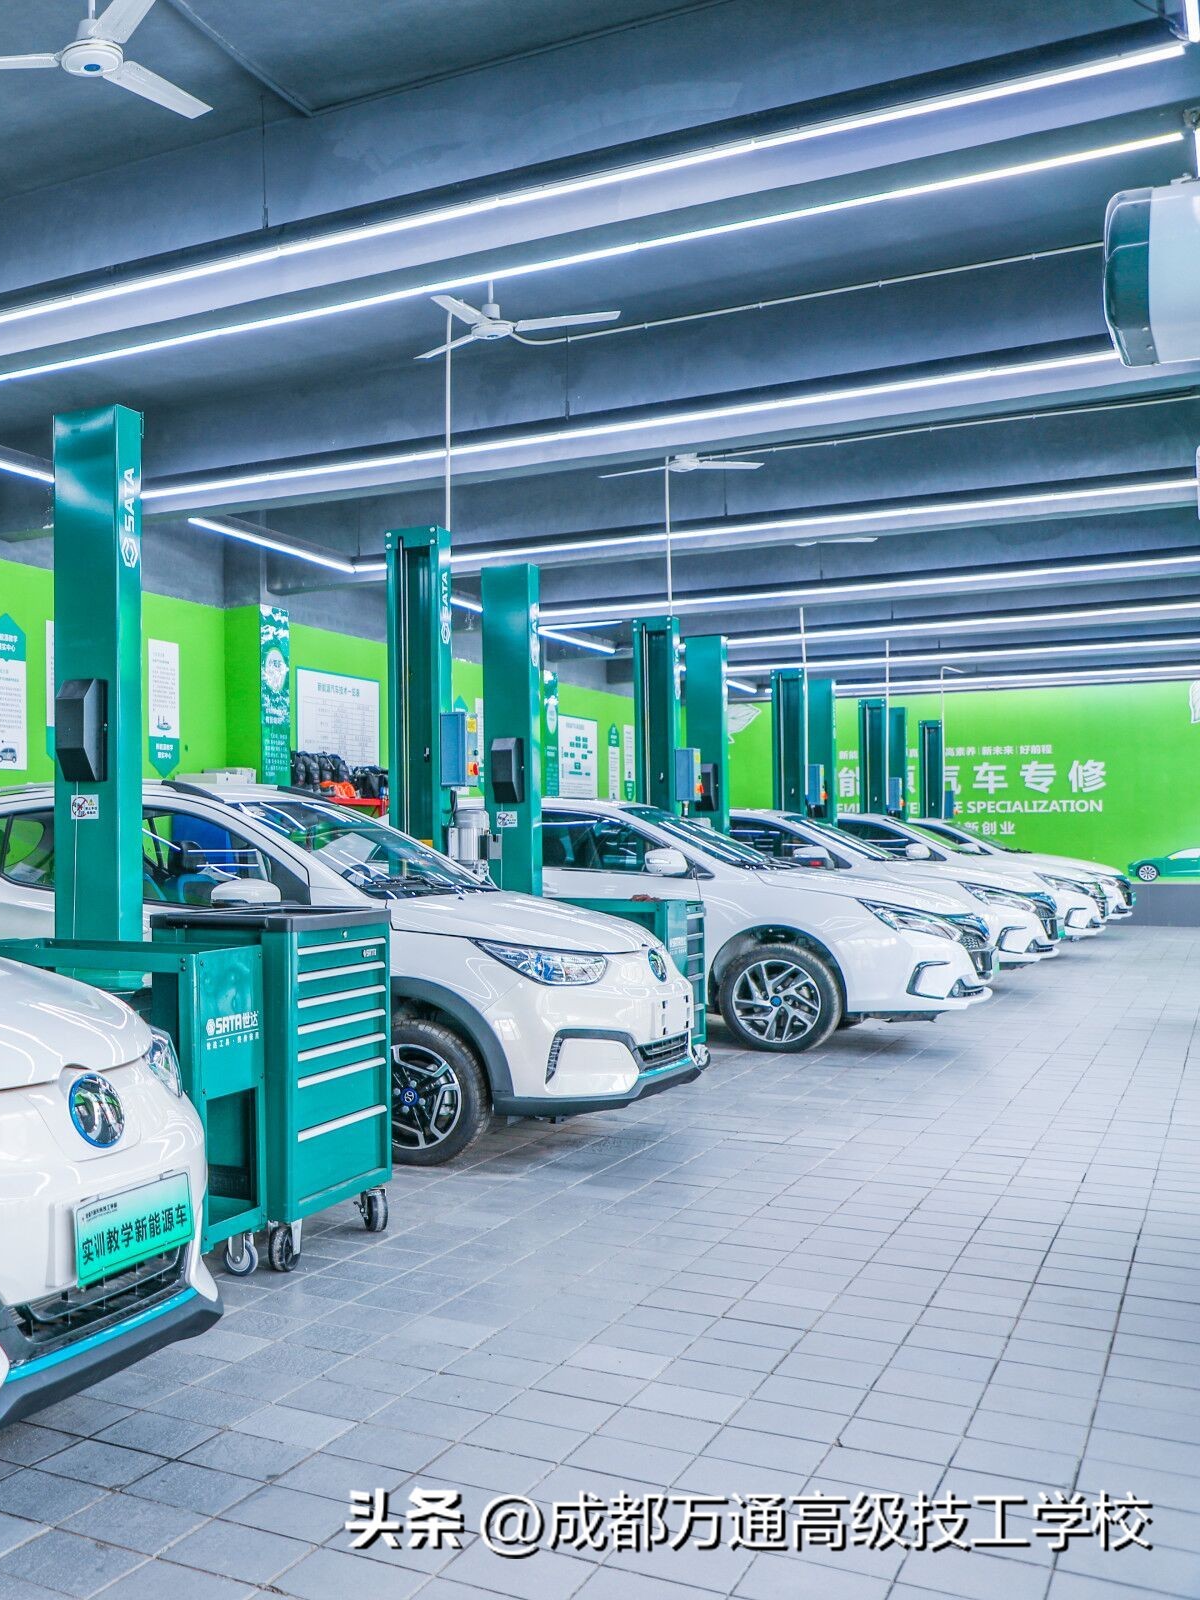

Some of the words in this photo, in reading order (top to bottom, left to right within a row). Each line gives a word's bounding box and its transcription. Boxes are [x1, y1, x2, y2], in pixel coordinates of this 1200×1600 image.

[123, 467, 135, 533] SATA
[981, 745, 1014, 756] 新未来
[966, 800, 1103, 813] SPECIALIZATION
[82, 1203, 188, 1266] 实训教学新能源车
